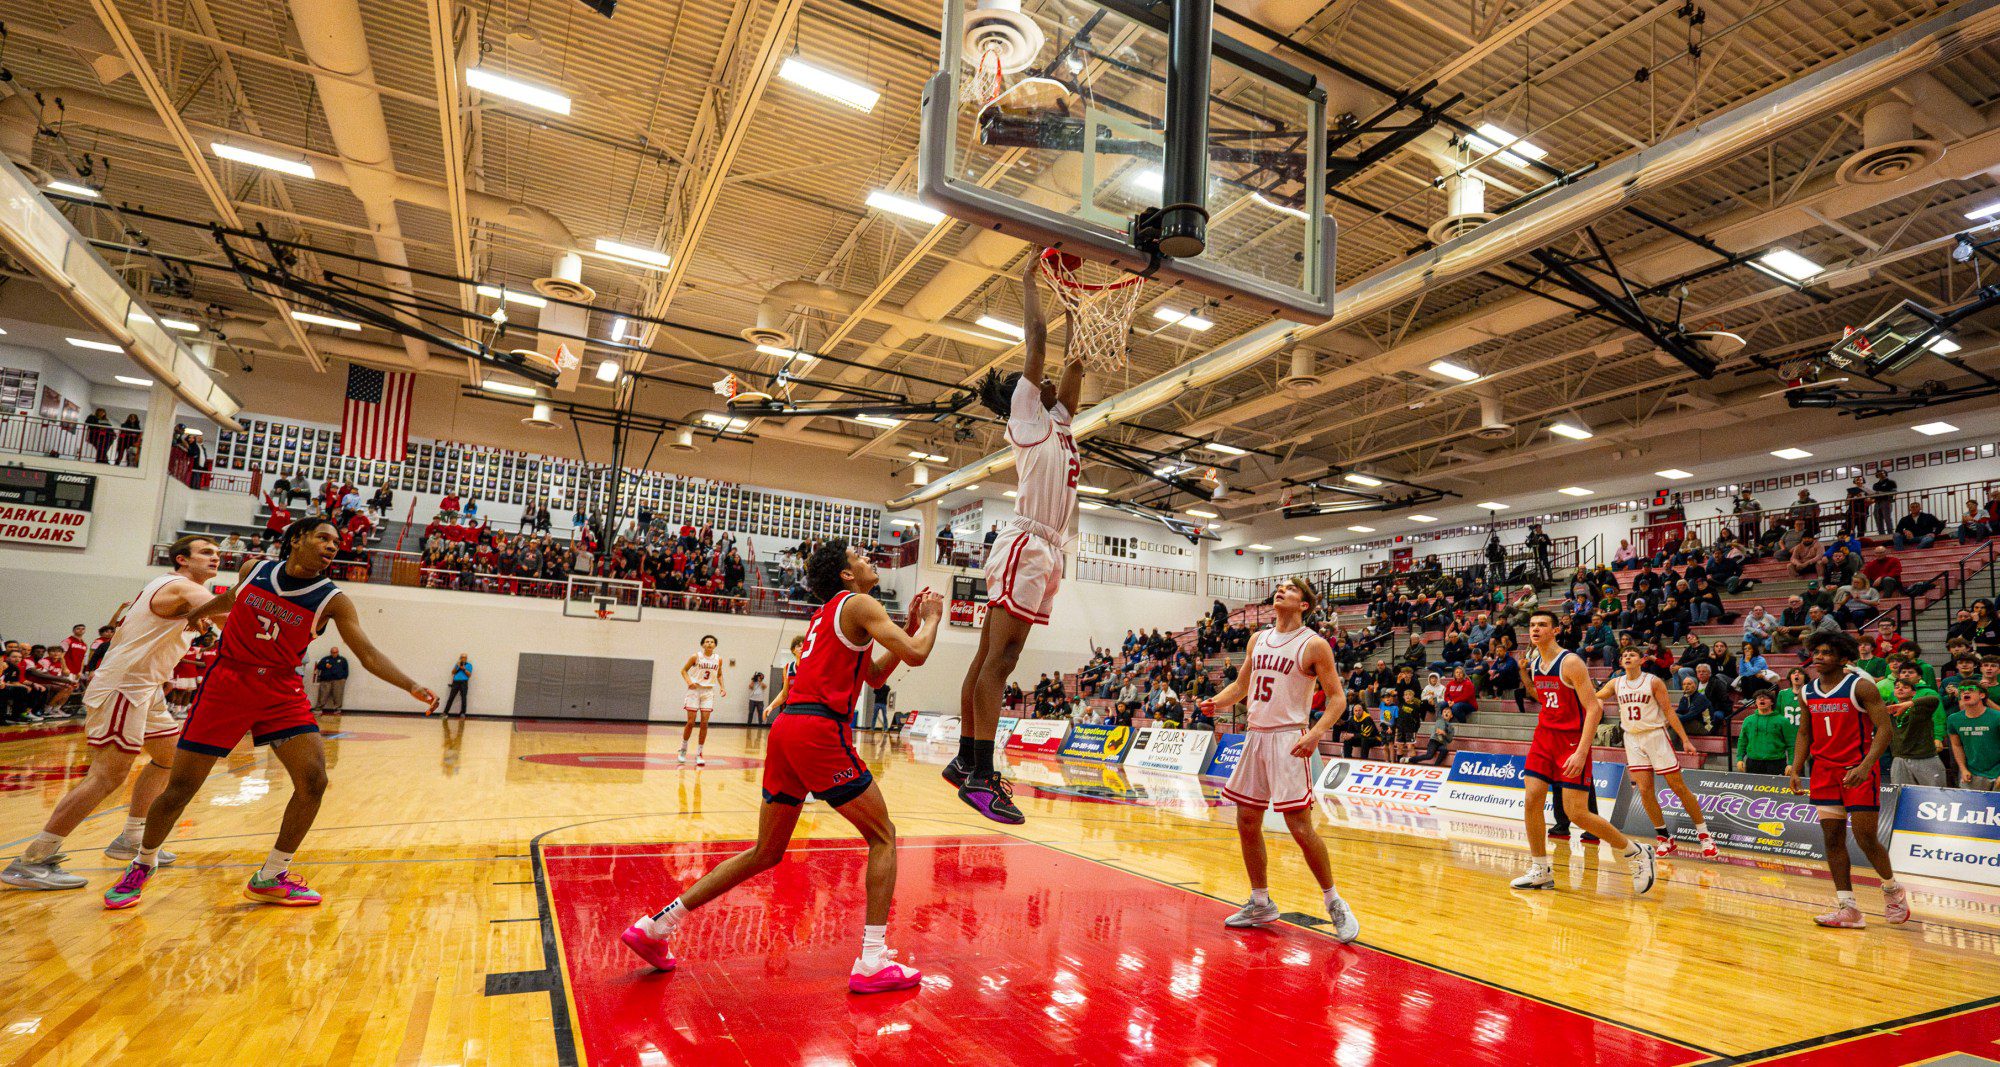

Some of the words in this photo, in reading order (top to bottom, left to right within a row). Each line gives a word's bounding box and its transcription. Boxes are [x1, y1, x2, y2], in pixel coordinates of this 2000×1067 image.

[435, 439, 528, 458] PARKLAND
[706, 478, 741, 489] FAME
[57, 474, 88, 484] HOME
[245, 592, 304, 627] COLONIALS
[256, 615, 280, 641] 31
[801, 617, 823, 660] 5
[703, 670, 711, 680] 3
[1253, 676, 1275, 702] 15
[1619, 693, 1651, 704] PARKLAND
[1627, 705, 1642, 721] 13
[1823, 715, 1833, 737] 1
[1157, 731, 1180, 742] FOUR
[1152, 742, 1184, 756] POINTS
[1219, 753, 1240, 763] THER
[833, 768, 854, 784] PW
[1359, 764, 1443, 780] STEW'S
[1350, 773, 1443, 794] TIRE
[1699, 780, 1714, 788] THE
[1714, 781, 1742, 790] LEADER
[1754, 785, 1779, 794] LOCAL
[1347, 785, 1431, 802] CENTER
[1450, 789, 1516, 808] Extraordinary
[1716, 832, 1730, 840] ON
[1809, 851, 1823, 859] App
